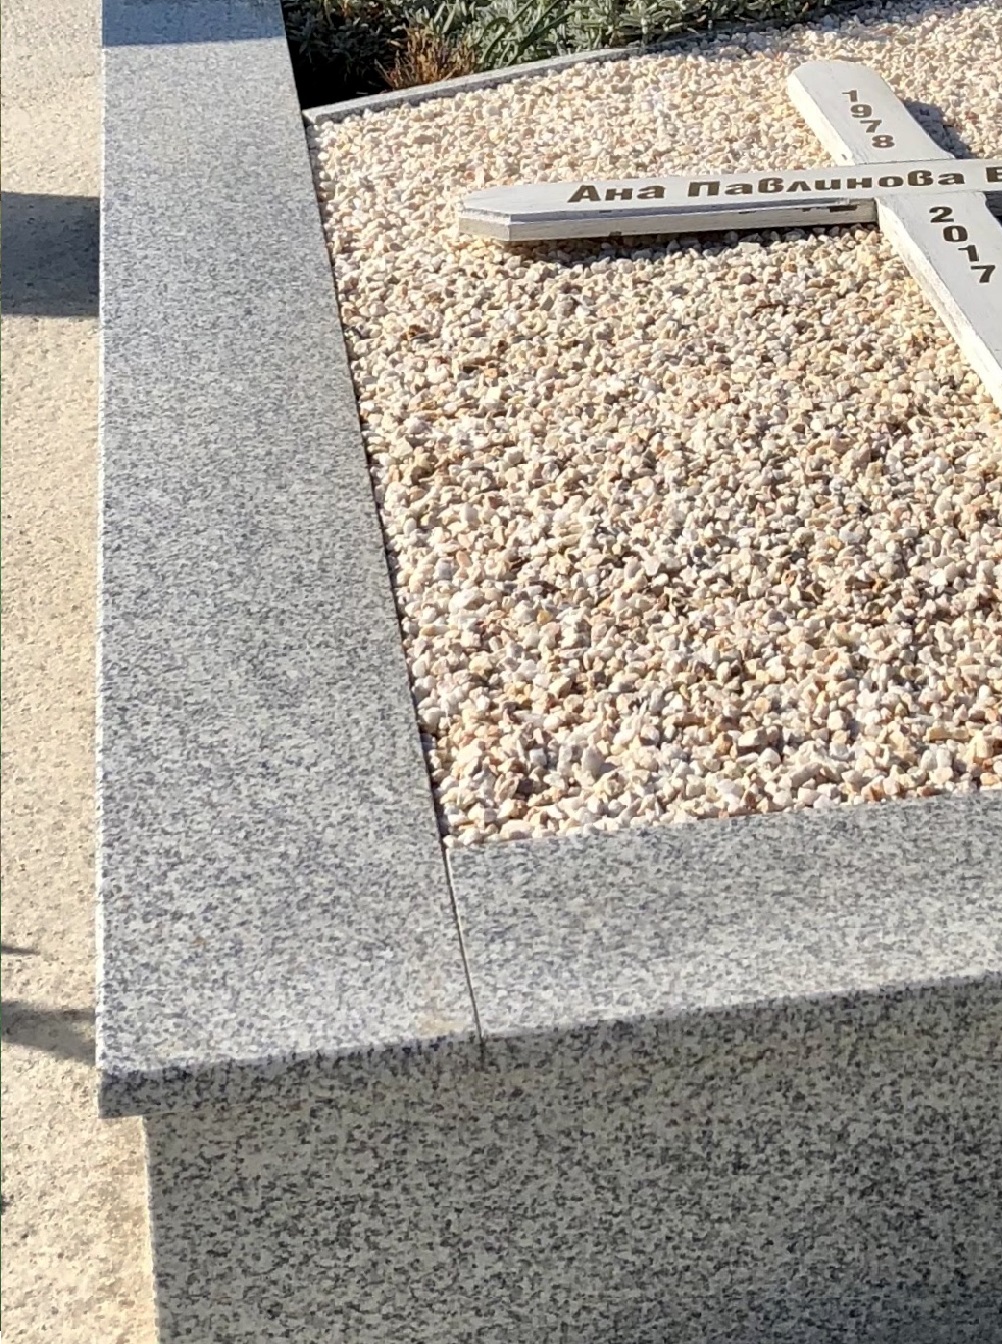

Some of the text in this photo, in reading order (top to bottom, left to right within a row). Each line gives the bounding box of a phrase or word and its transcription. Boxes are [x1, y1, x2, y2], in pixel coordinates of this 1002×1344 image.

[841, 88, 896, 149] 1978
[566, 181, 666, 204] Ана
[686, 169, 966, 201] Павлинова
[928, 205, 997, 284] 2017
